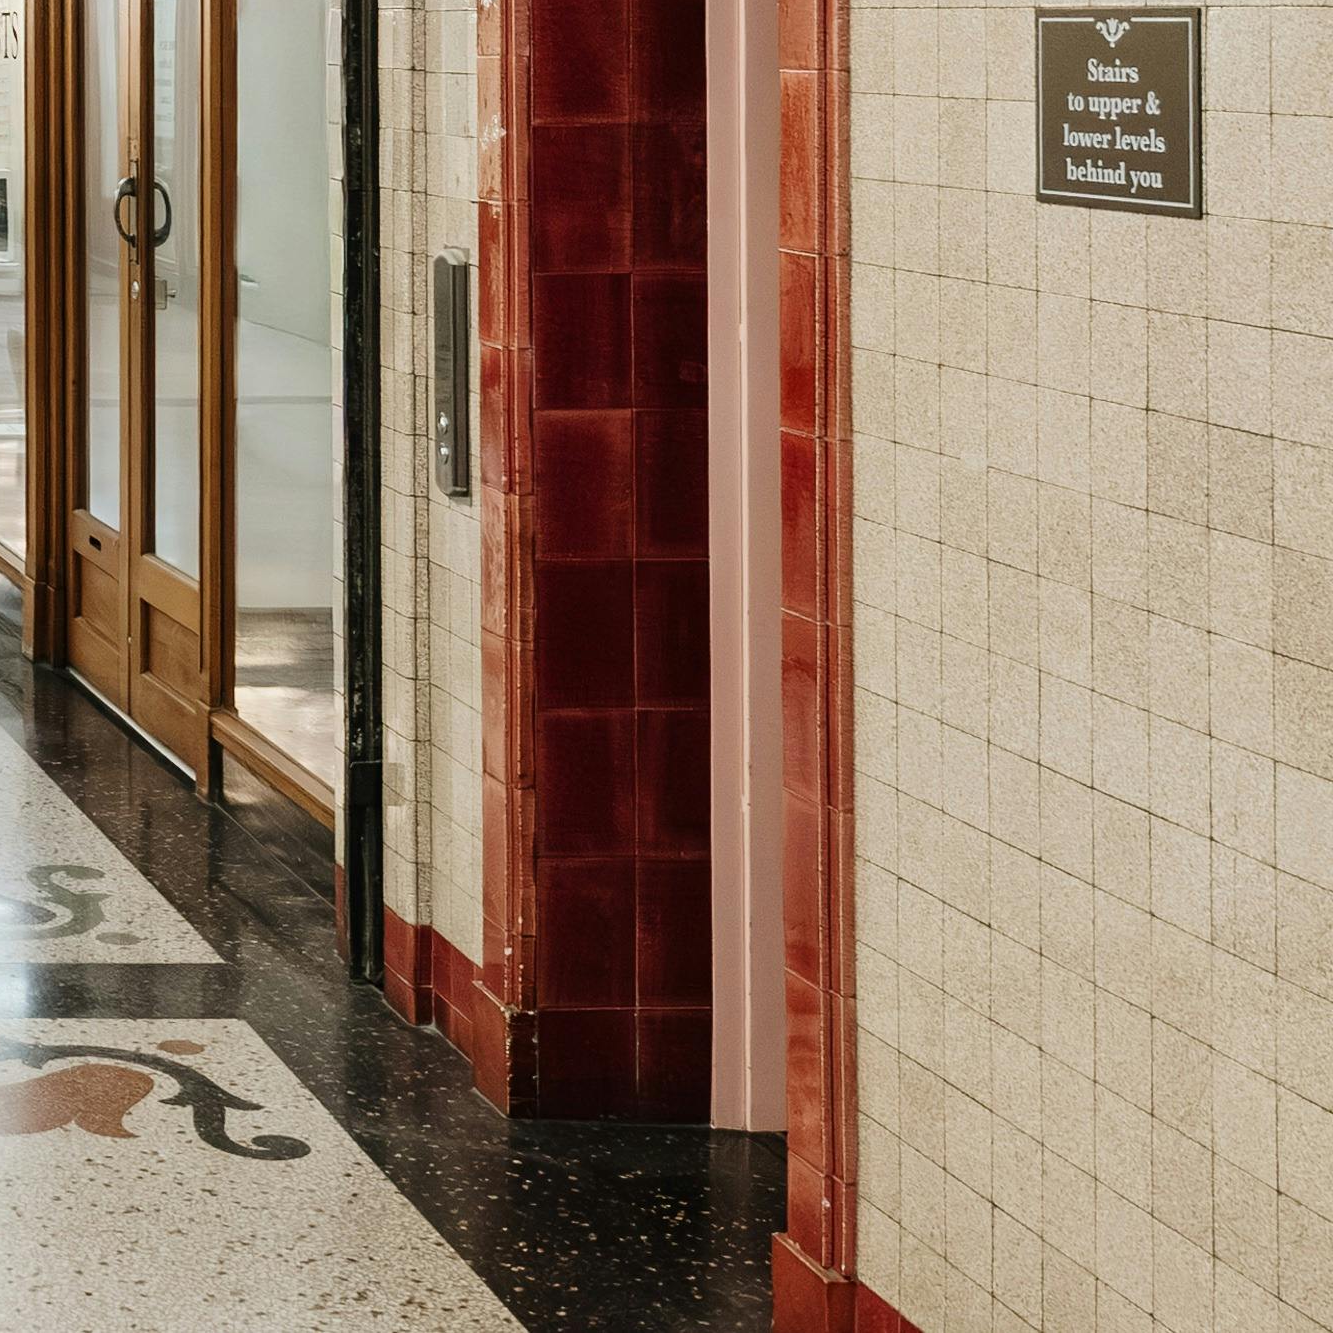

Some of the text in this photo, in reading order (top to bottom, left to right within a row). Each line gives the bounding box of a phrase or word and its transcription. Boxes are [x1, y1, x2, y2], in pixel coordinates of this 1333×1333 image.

[1087, 58, 1140, 84] Stairs
[1067, 91, 1161, 121] to upper &
[1063, 123, 1166, 153] lower levels
[1066, 157, 1163, 193] behind you
